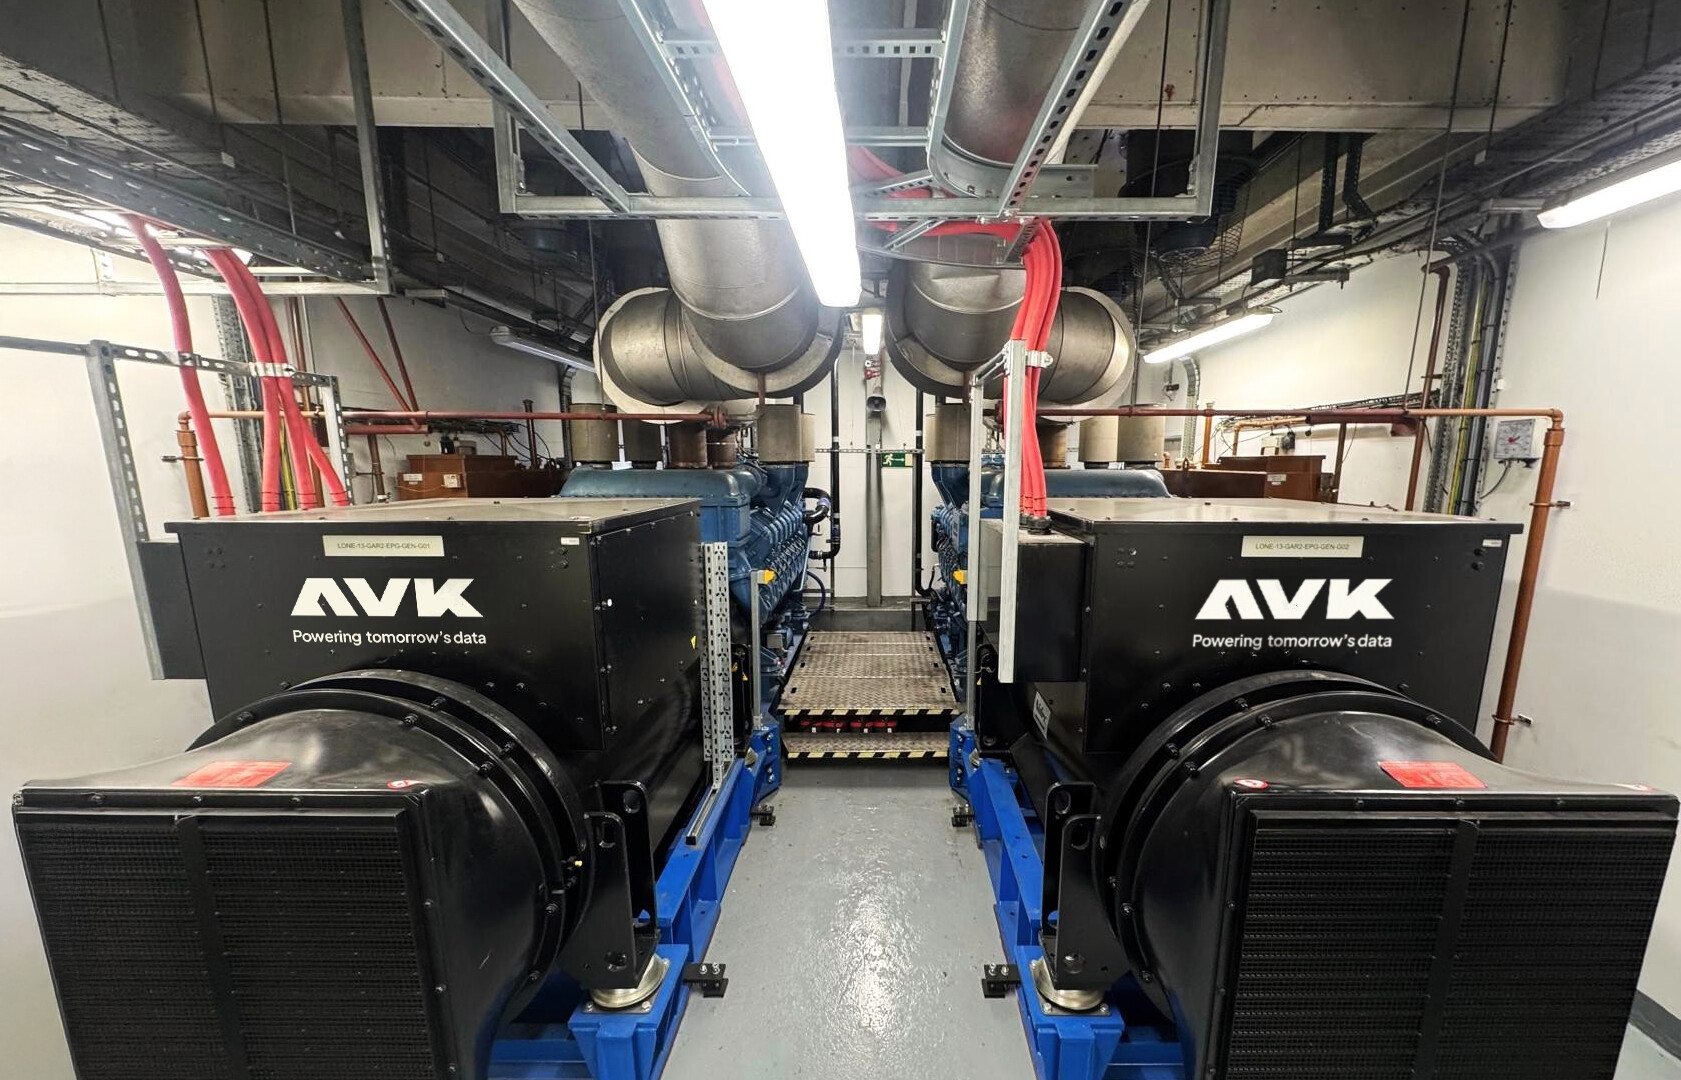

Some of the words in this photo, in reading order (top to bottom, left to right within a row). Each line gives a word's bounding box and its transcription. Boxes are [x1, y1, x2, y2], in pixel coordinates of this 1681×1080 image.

[291, 577, 484, 618] AVK
[1195, 578, 1395, 620] AVK
[292, 629, 362, 646] Powering
[453, 631, 487, 645] data
[1192, 634, 1263, 650] Powering
[1357, 634, 1393, 648] data
